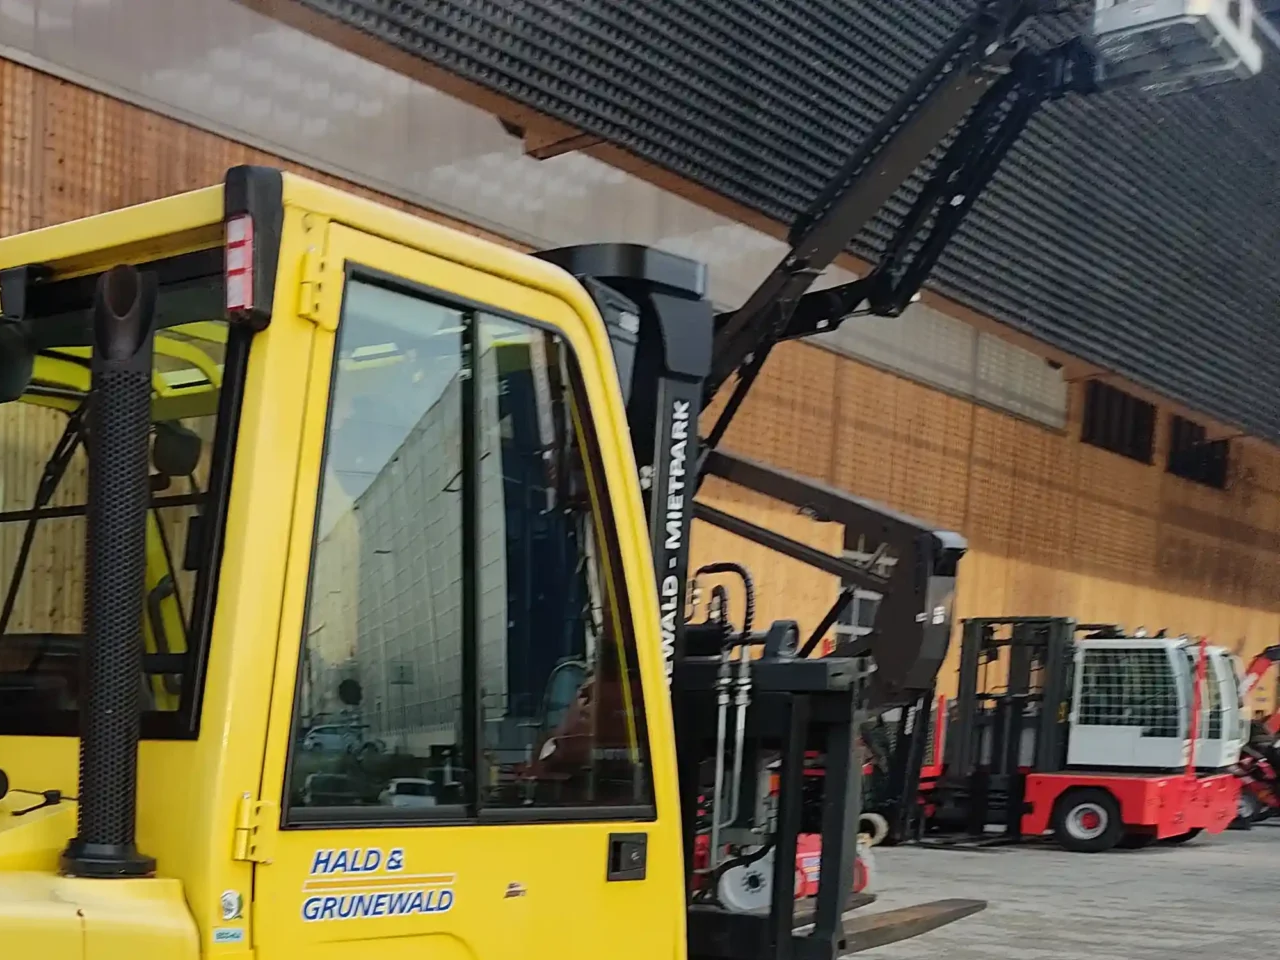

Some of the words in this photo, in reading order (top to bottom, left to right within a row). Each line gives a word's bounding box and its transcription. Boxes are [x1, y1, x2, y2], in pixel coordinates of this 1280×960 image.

[665, 400, 690, 550] MIETPARK
[310, 849, 381, 875] HALD
[386, 849, 404, 871] &
[302, 889, 454, 921] GRUNEWALD
